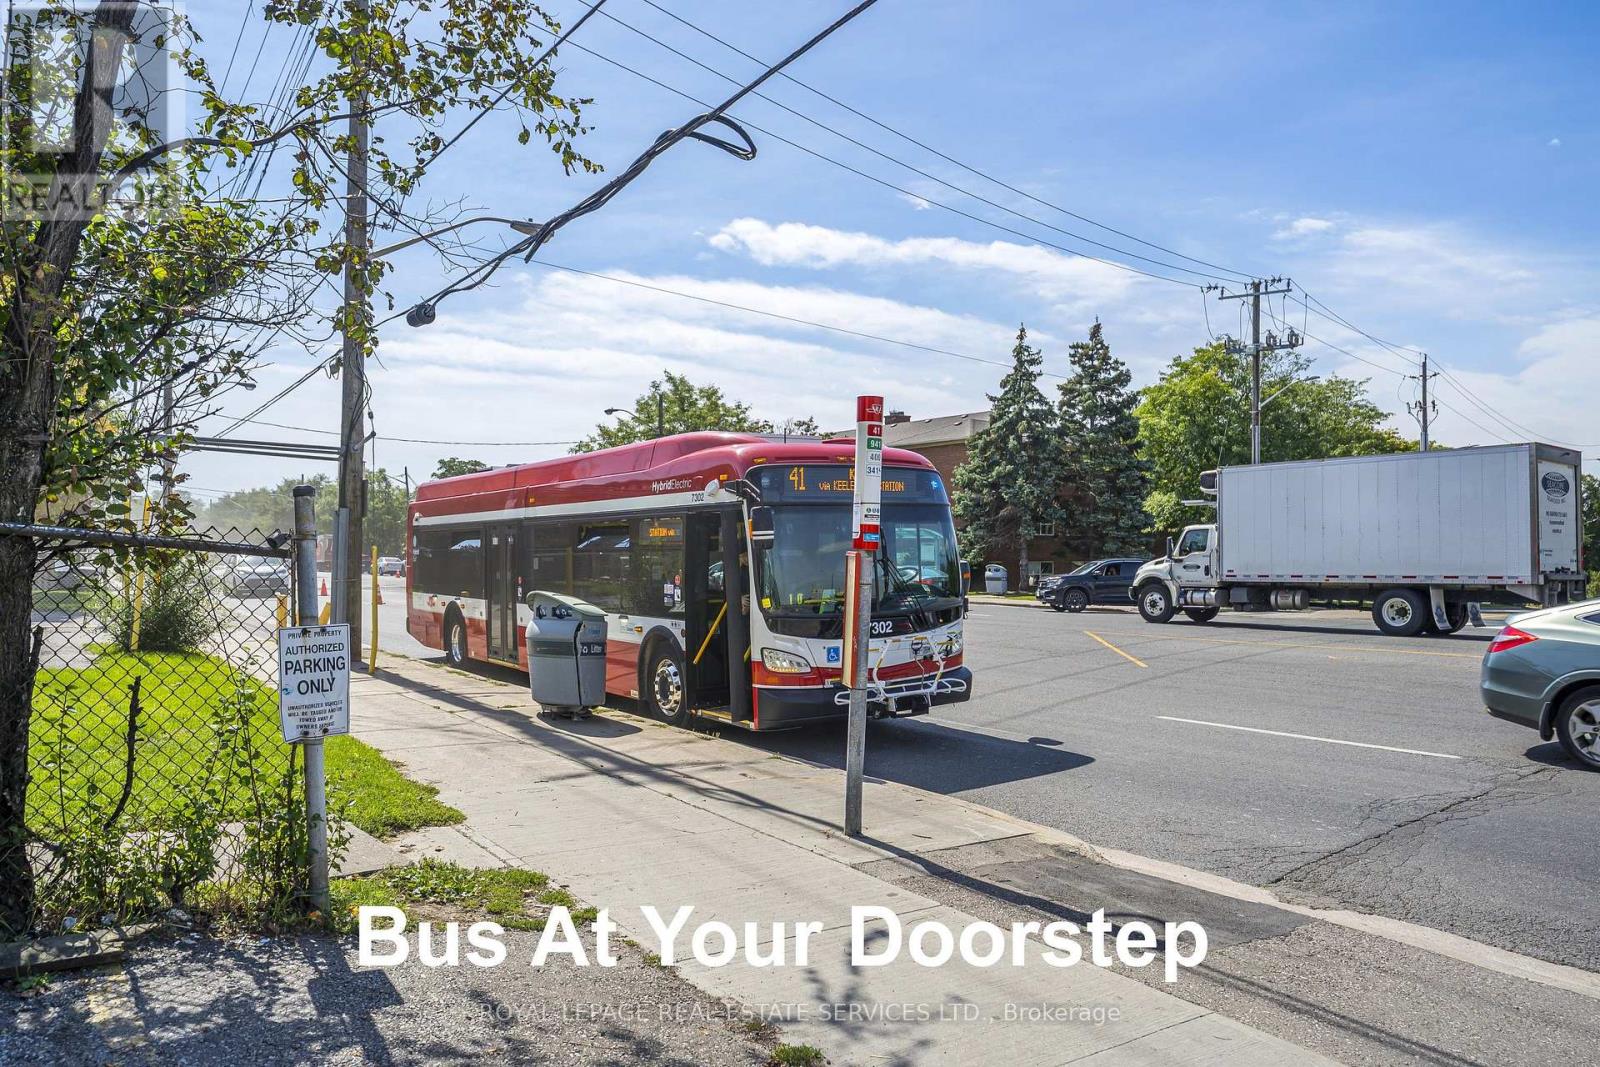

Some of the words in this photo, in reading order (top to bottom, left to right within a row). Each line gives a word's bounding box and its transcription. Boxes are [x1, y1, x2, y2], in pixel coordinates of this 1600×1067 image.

[872, 426, 880, 436] 41
[651, 478, 693, 493] HybridElectric
[789, 466, 806, 491] 41
[833, 480, 855, 490] KEELE
[880, 480, 905, 492] TATION
[691, 492, 705, 502] 7302
[313, 629, 342, 638] PROPERTY
[870, 620, 893, 635] 302
[285, 642, 345, 656] AUTHORIZED
[284, 655, 346, 676] PARKING
[297, 677, 336, 696] ONLY
